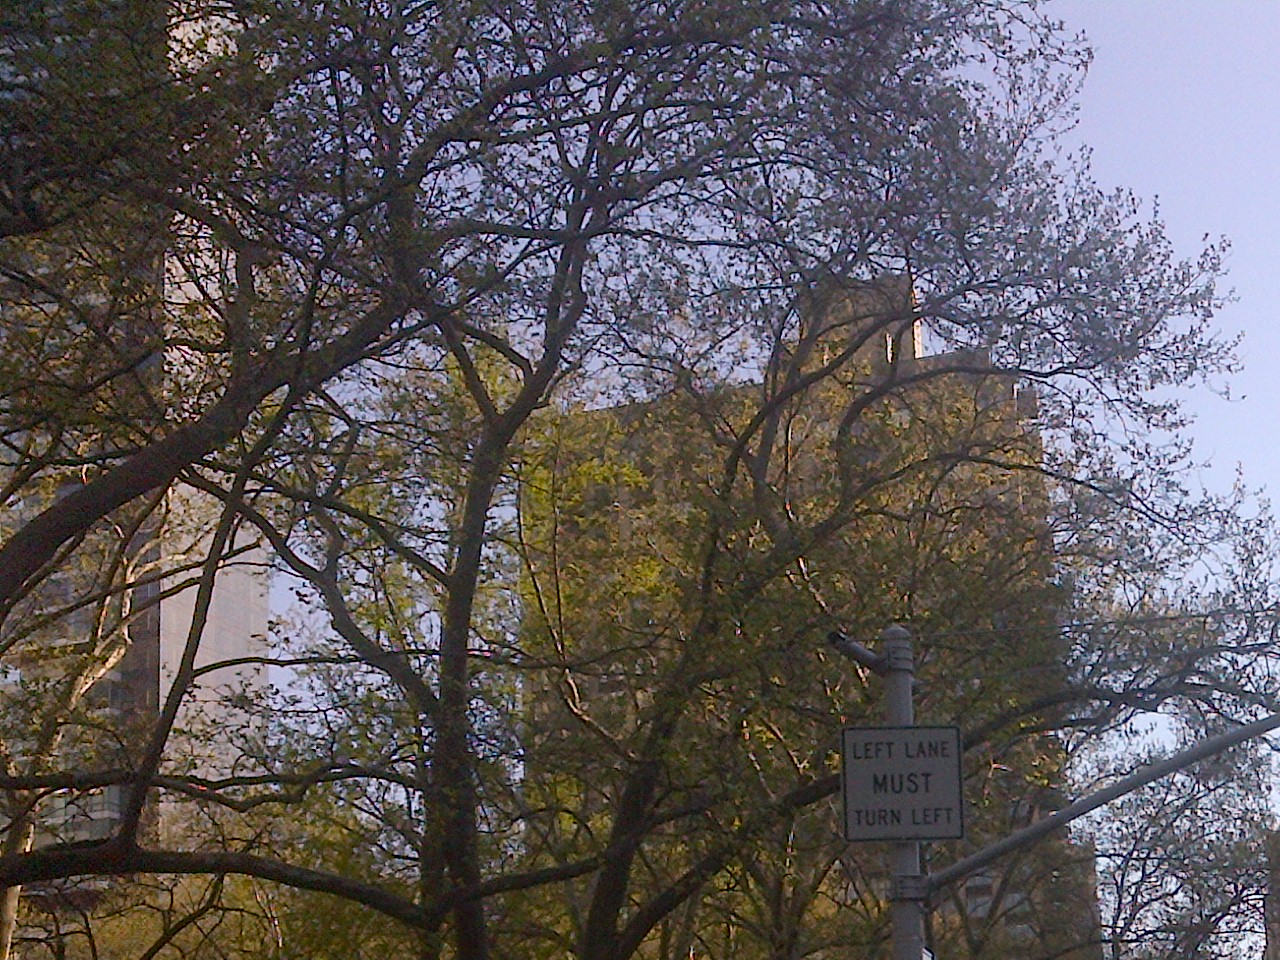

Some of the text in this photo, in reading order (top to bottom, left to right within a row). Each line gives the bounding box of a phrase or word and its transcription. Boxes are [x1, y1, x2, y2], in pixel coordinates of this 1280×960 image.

[853, 741, 950, 760] LEFT LANE
[872, 772, 932, 794] MUST
[854, 808, 954, 826] TURN LEFT
